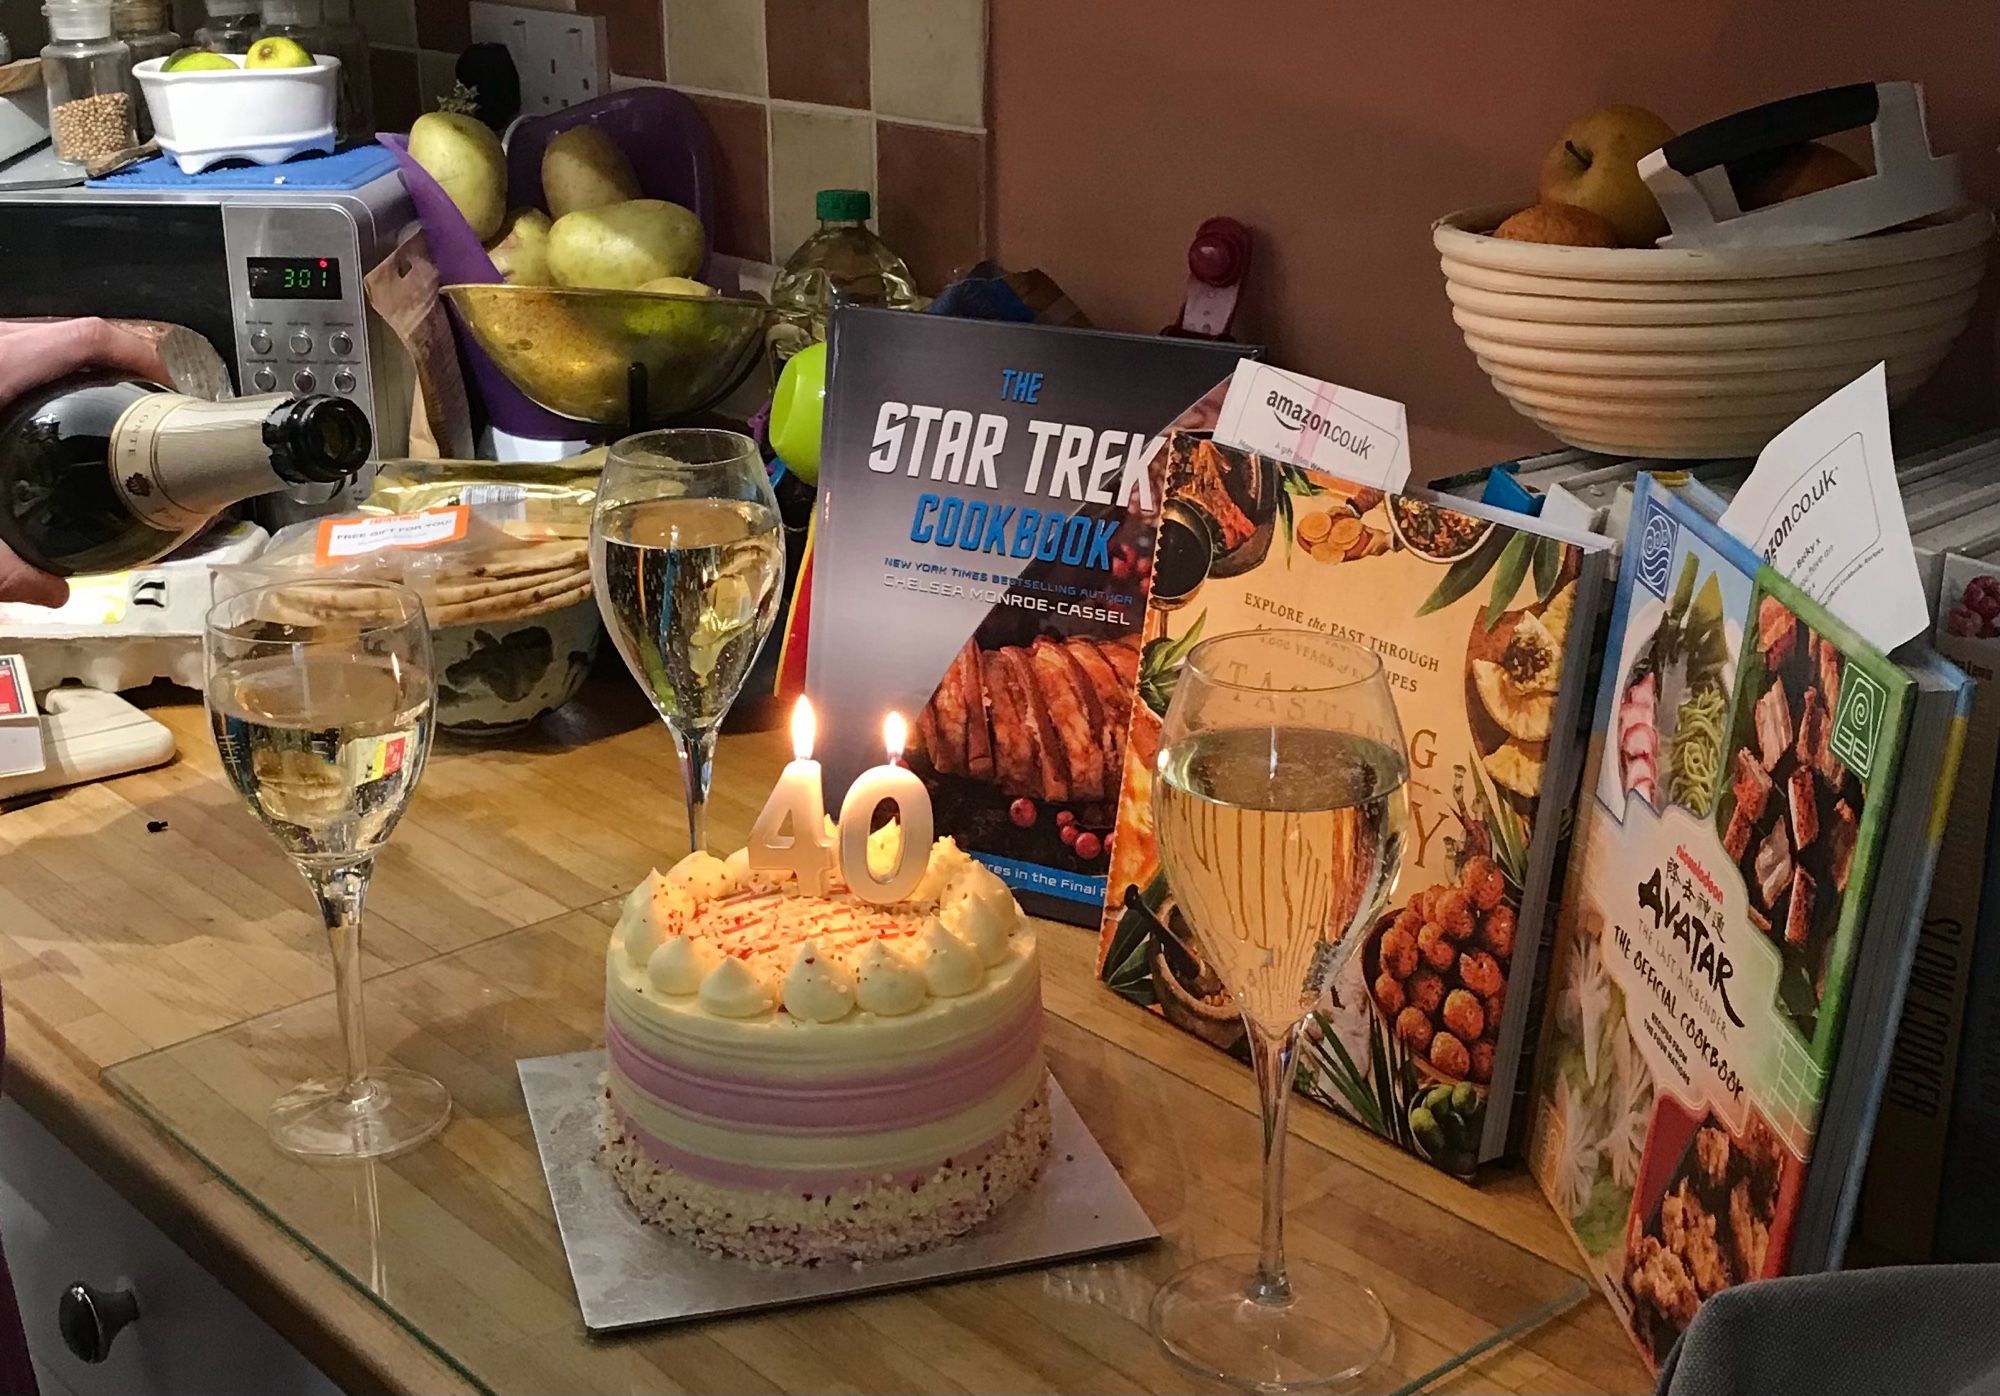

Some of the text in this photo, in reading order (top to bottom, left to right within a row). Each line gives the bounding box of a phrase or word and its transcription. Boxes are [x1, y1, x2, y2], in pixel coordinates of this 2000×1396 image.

[1000, 368, 1044, 404] THE
[1266, 390, 1371, 460] amazon.co.uk
[868, 401, 1168, 511] STAR TREK
[910, 493, 1120, 571] COOKBOOK
[1763, 469, 1837, 567] azon.co.uk
[883, 574, 1131, 626] CHELSEA MONROE-CASSEL
[884, 557, 1133, 605] NEW YORK TIMES BESTSELLING AUTHOR
[1245, 592, 1440, 672] EXPLORE the PAST THROUGH
[748, 757, 934, 905] 40
[1015, 868, 1028, 880] in
[1032, 872, 1057, 886] the
[1061, 879, 1096, 896] Final
[1638, 918, 1653, 944] THE
[1656, 940, 1676, 972] LAST
[1638, 867, 1745, 1028] AVATAR
[1614, 925, 1744, 1105] THE OFFICIAL COOKBOOK
